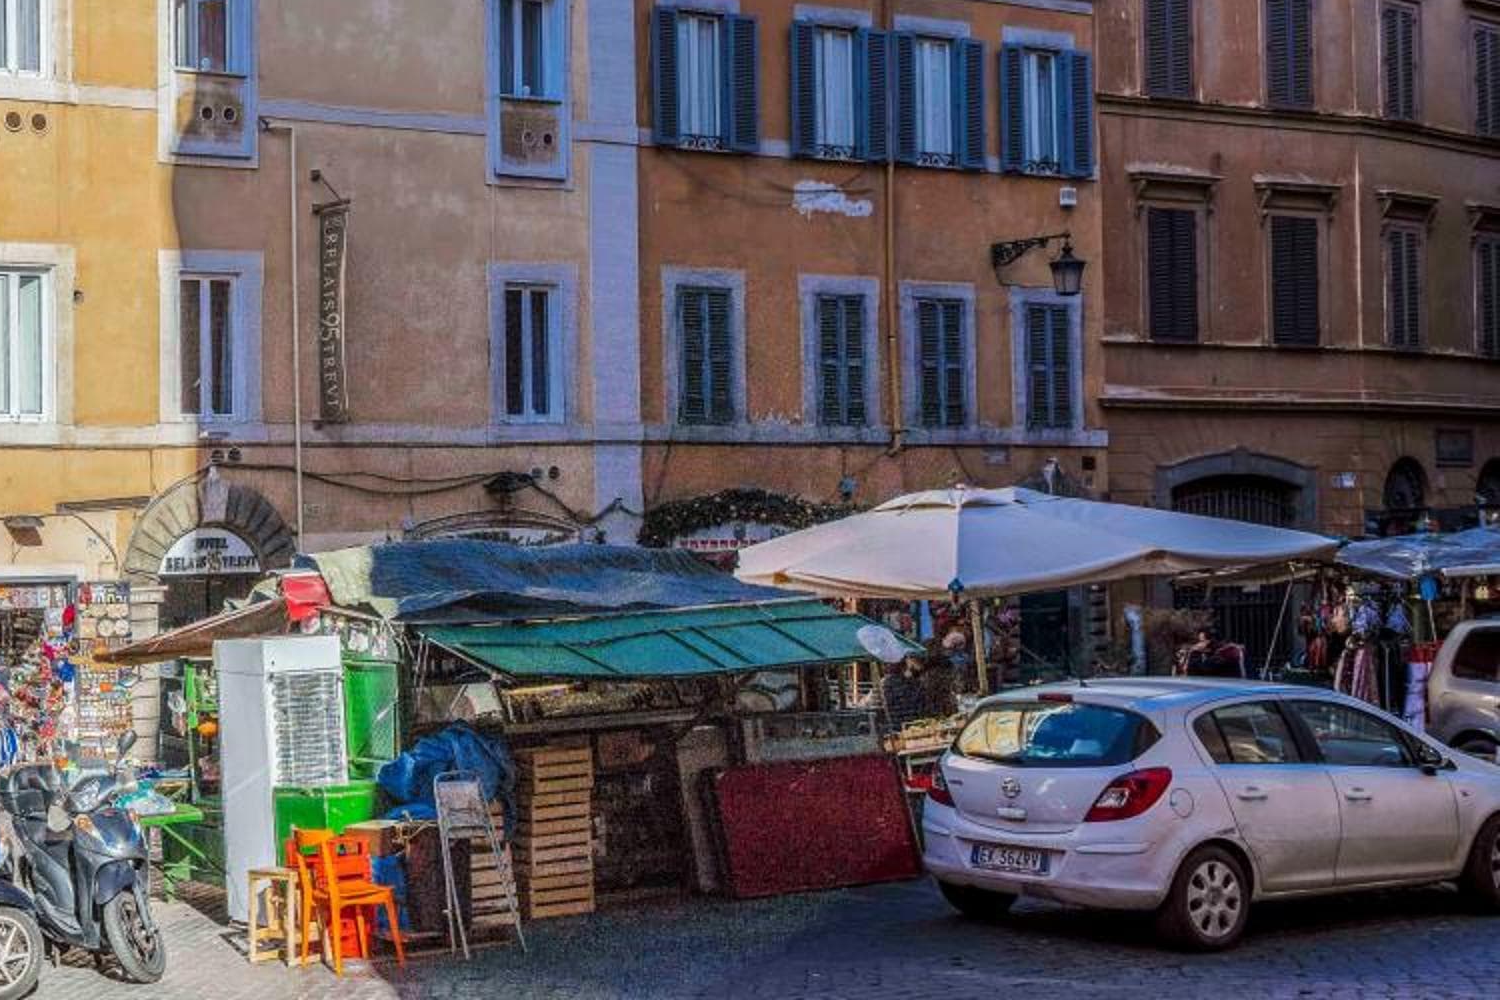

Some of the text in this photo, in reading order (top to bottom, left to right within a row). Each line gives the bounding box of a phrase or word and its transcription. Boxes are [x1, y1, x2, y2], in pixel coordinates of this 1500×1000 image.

[320, 233, 340, 408] RELAIS 95 TREVI
